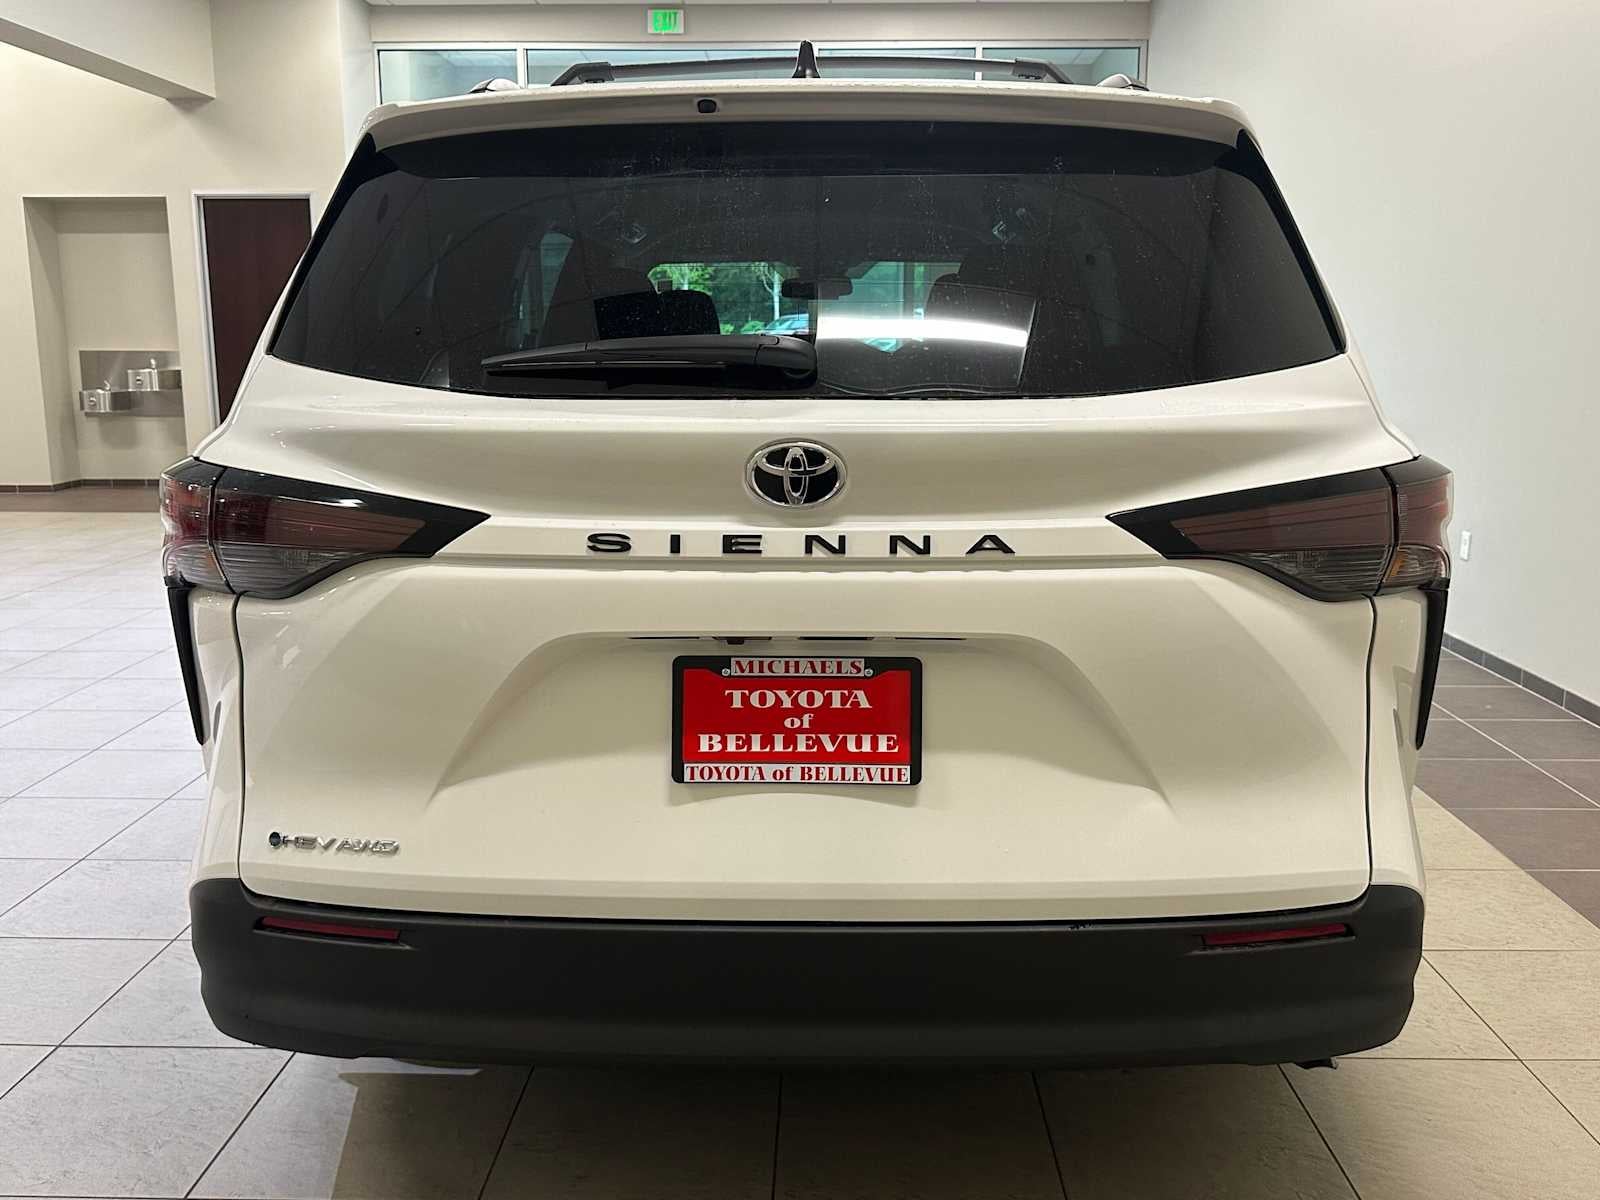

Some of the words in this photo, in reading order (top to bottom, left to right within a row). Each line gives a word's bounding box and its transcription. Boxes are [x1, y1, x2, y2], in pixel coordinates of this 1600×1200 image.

[653, 11, 678, 31] EXIT
[587, 532, 1016, 554] SIENNA
[734, 659, 862, 674] MICHAELS
[725, 689, 872, 708] TOYOTA
[783, 713, 814, 729] of
[697, 733, 899, 753] BELLEVUE
[685, 765, 766, 781] TOYOTA
[772, 765, 794, 781] of
[800, 766, 908, 782] BELLEVUE
